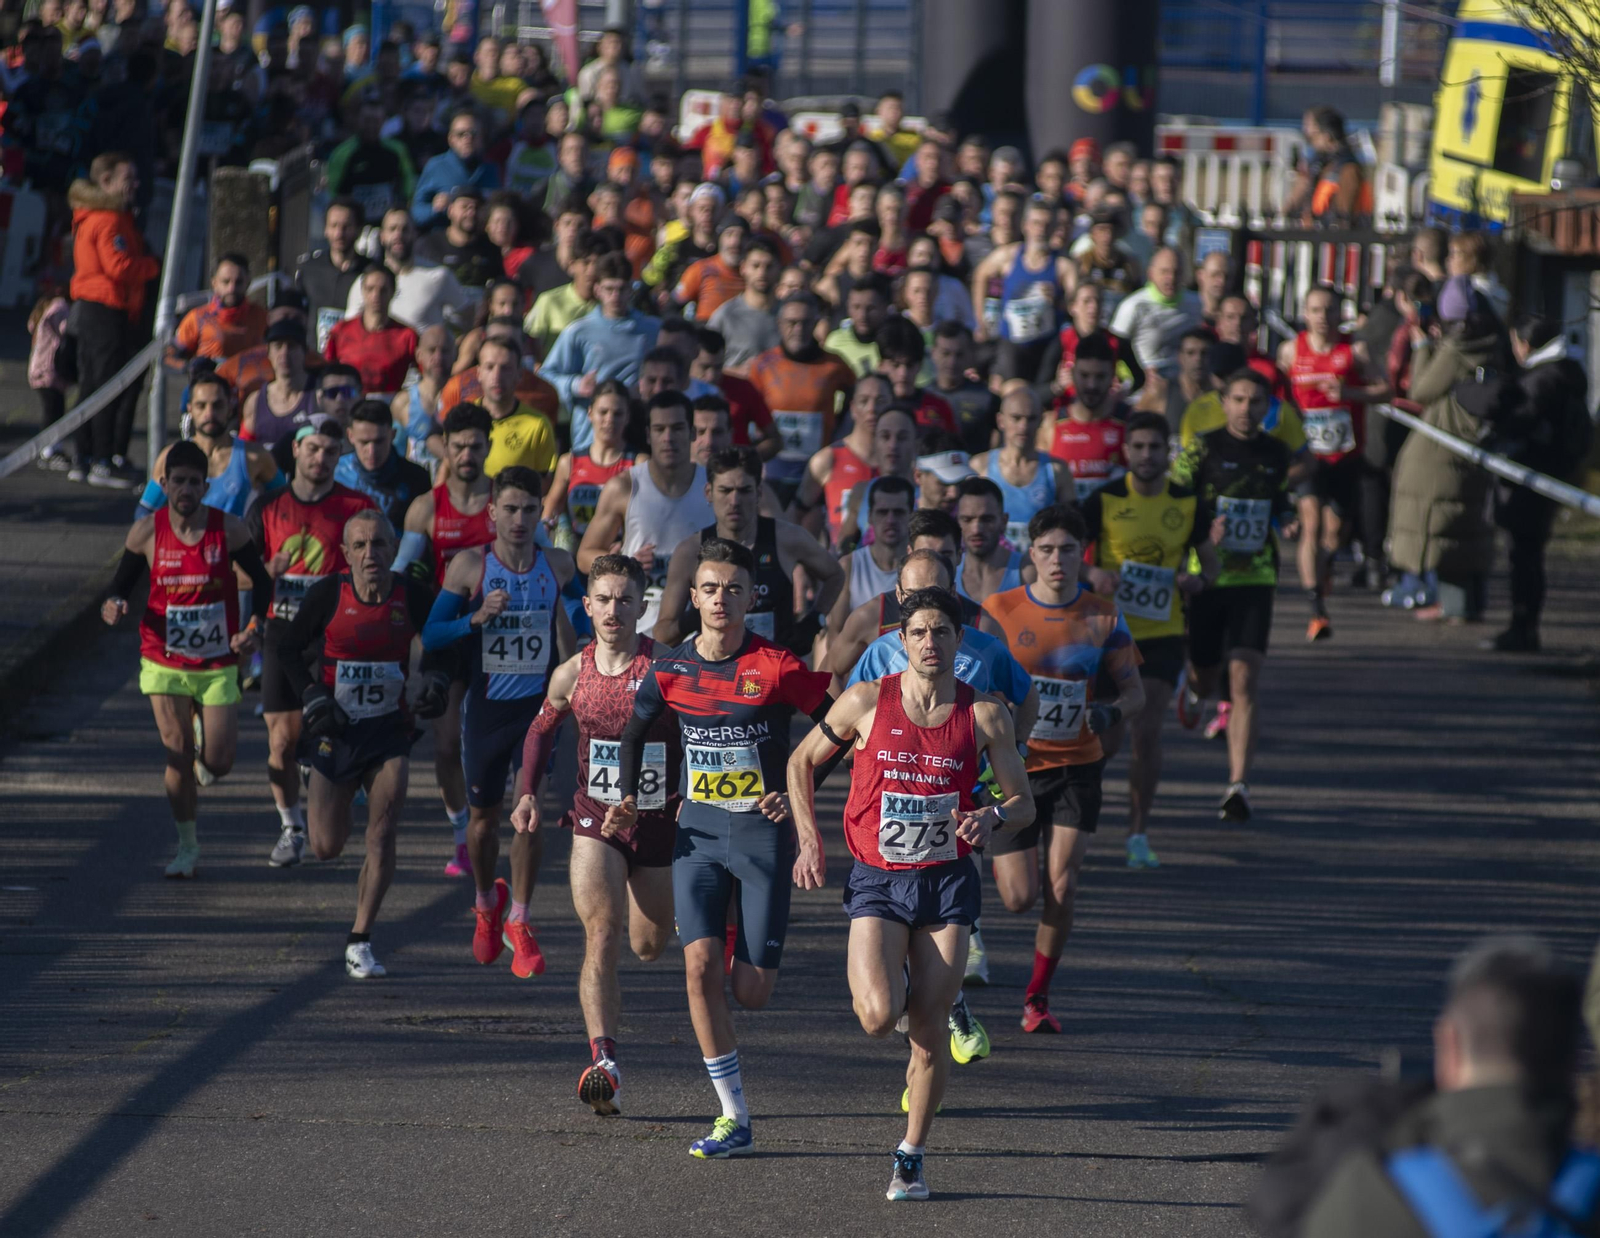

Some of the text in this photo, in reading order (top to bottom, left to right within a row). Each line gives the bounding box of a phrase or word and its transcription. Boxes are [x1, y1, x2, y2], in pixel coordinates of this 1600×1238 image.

[1118, 580, 1170, 609] 360
[169, 610, 199, 623] XXII
[169, 624, 223, 649] 264
[488, 635, 542, 661] 419
[341, 666, 372, 679] XXII
[351, 685, 385, 705] 15
[689, 749, 722, 766] XXII
[877, 750, 964, 771] ALEX TEAM
[693, 771, 762, 799] 462
[885, 797, 924, 814] XXII
[884, 820, 950, 848] 273
